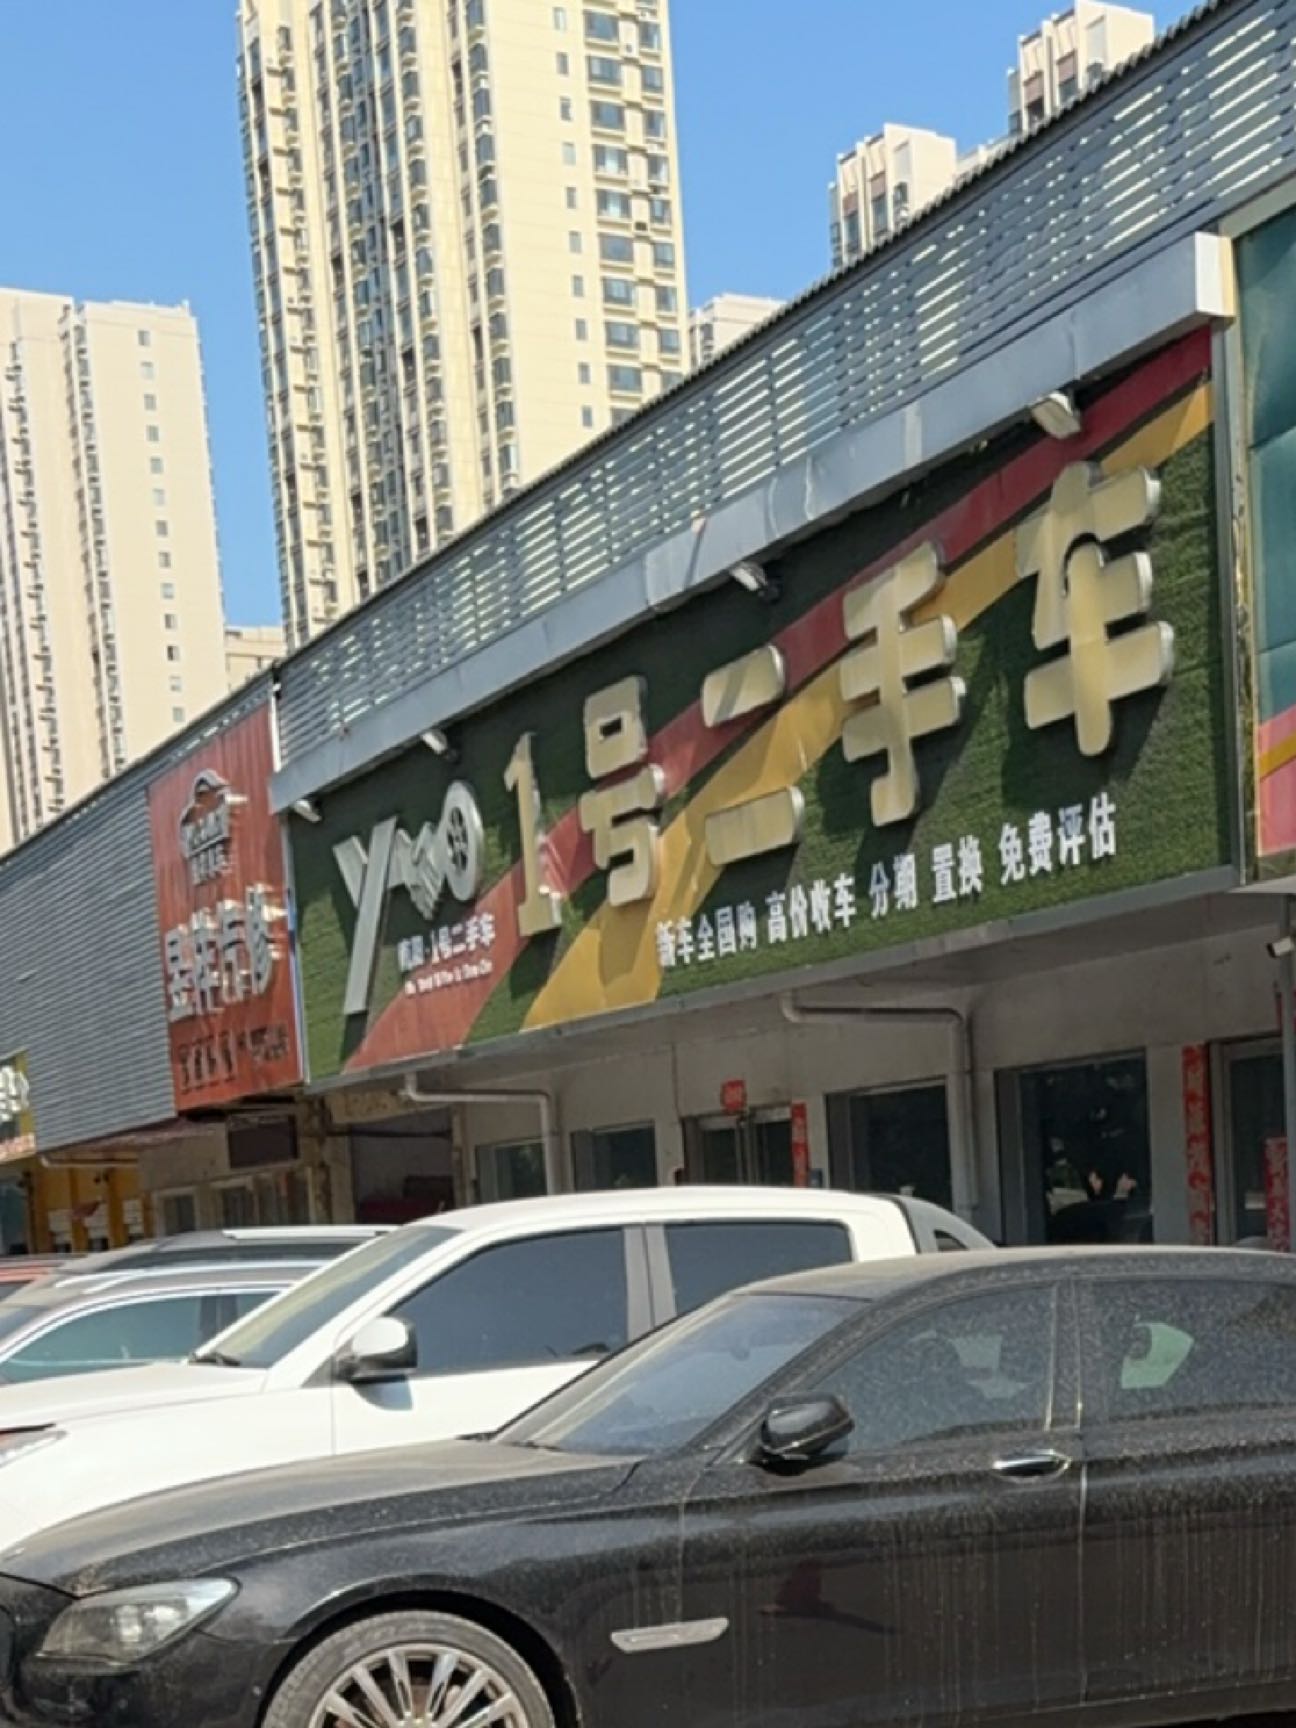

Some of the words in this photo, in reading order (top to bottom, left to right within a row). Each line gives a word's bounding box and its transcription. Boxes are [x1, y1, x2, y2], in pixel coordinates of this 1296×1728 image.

[504, 461, 1175, 938] 1号二手车
[999, 792, 1116, 886] 免费评估
